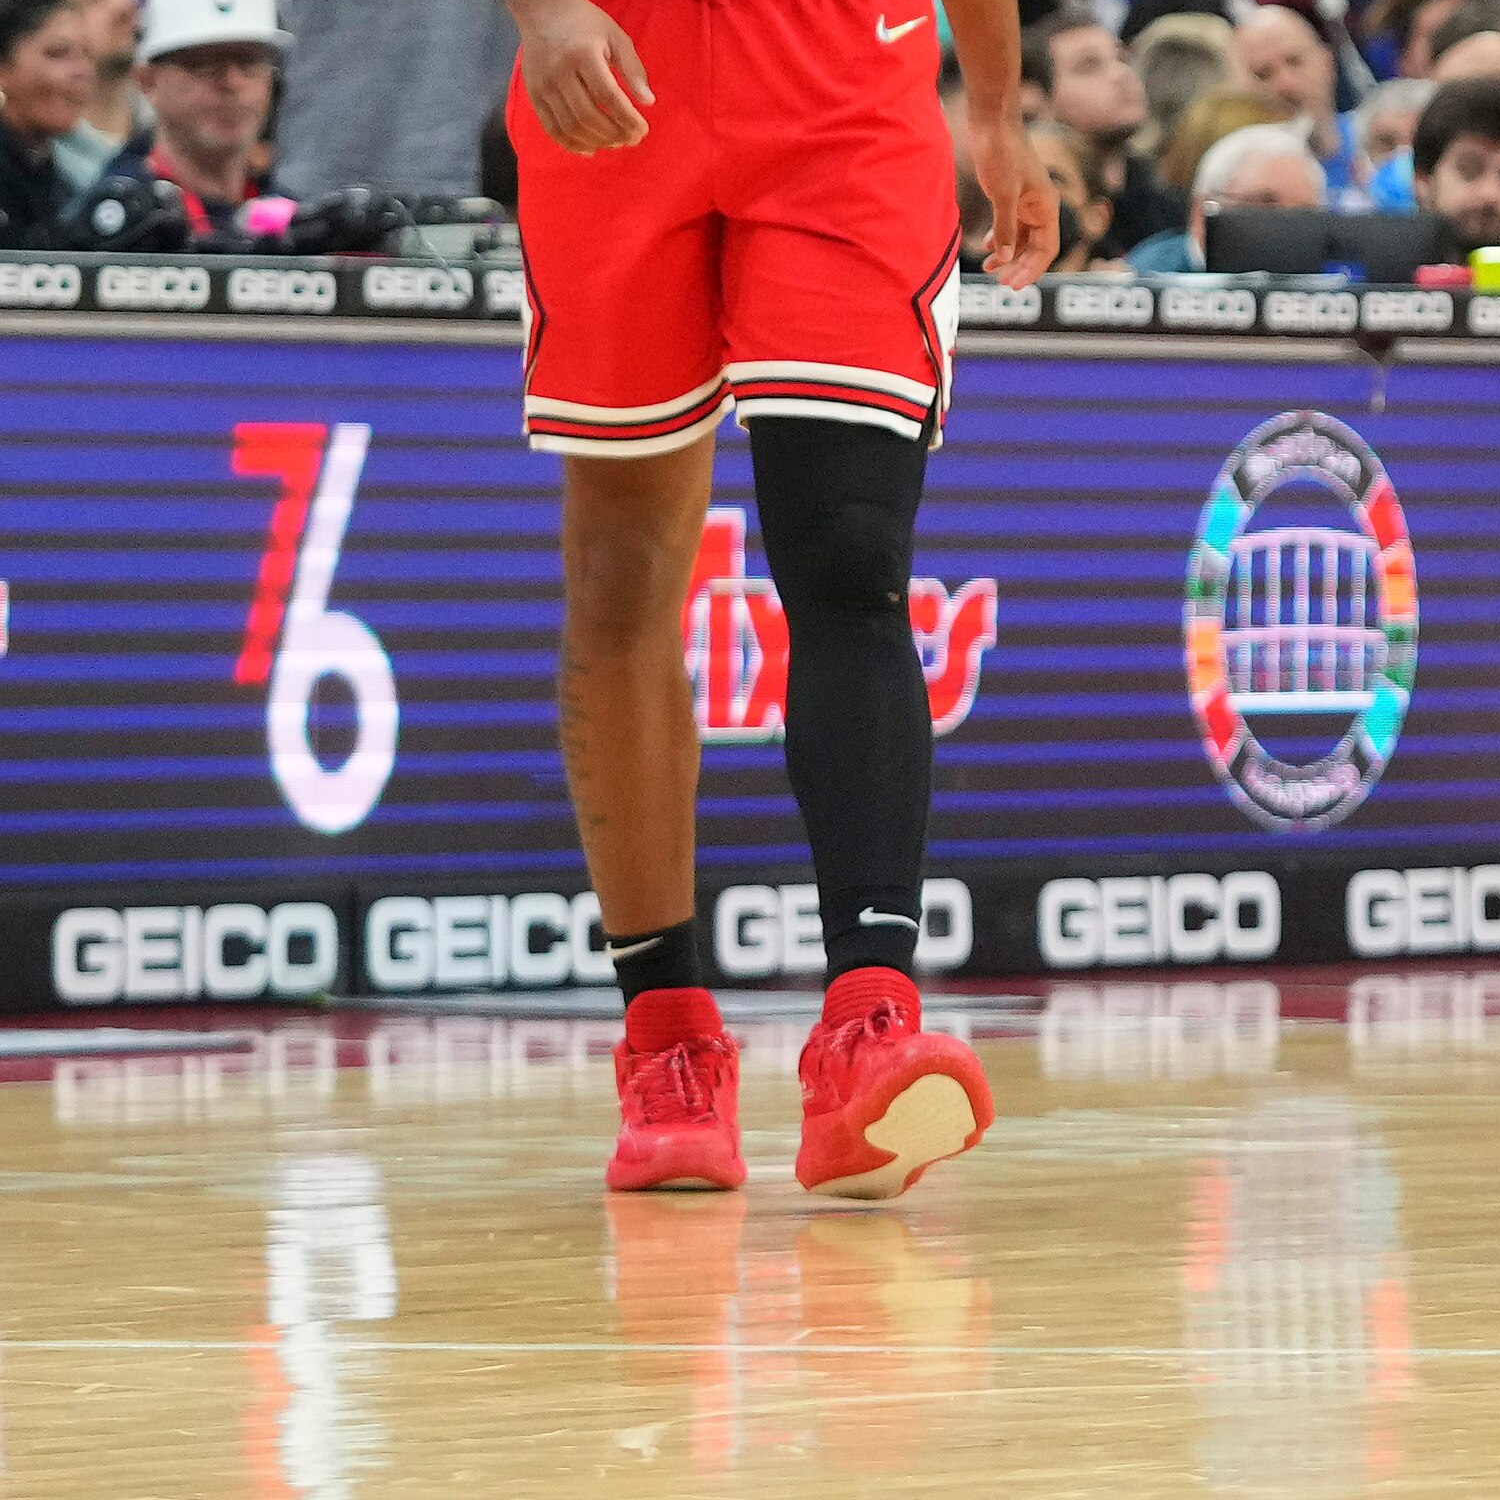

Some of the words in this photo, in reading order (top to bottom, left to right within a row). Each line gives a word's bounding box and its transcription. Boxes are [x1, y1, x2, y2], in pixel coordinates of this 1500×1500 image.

[0, 262, 82, 308] EICO
[97, 265, 211, 309] GEICO
[227, 267, 338, 313] GEICO
[363, 265, 475, 311] GEICO
[1056, 284, 1154, 327] GEICO
[1159, 287, 1257, 330] GEICO
[1263, 291, 1359, 332] GEICO
[1361, 291, 1454, 332] GEICO
[714, 876, 974, 978] GEO
[1038, 869, 1281, 966] GEICO
[53, 903, 338, 1005] GEICO
